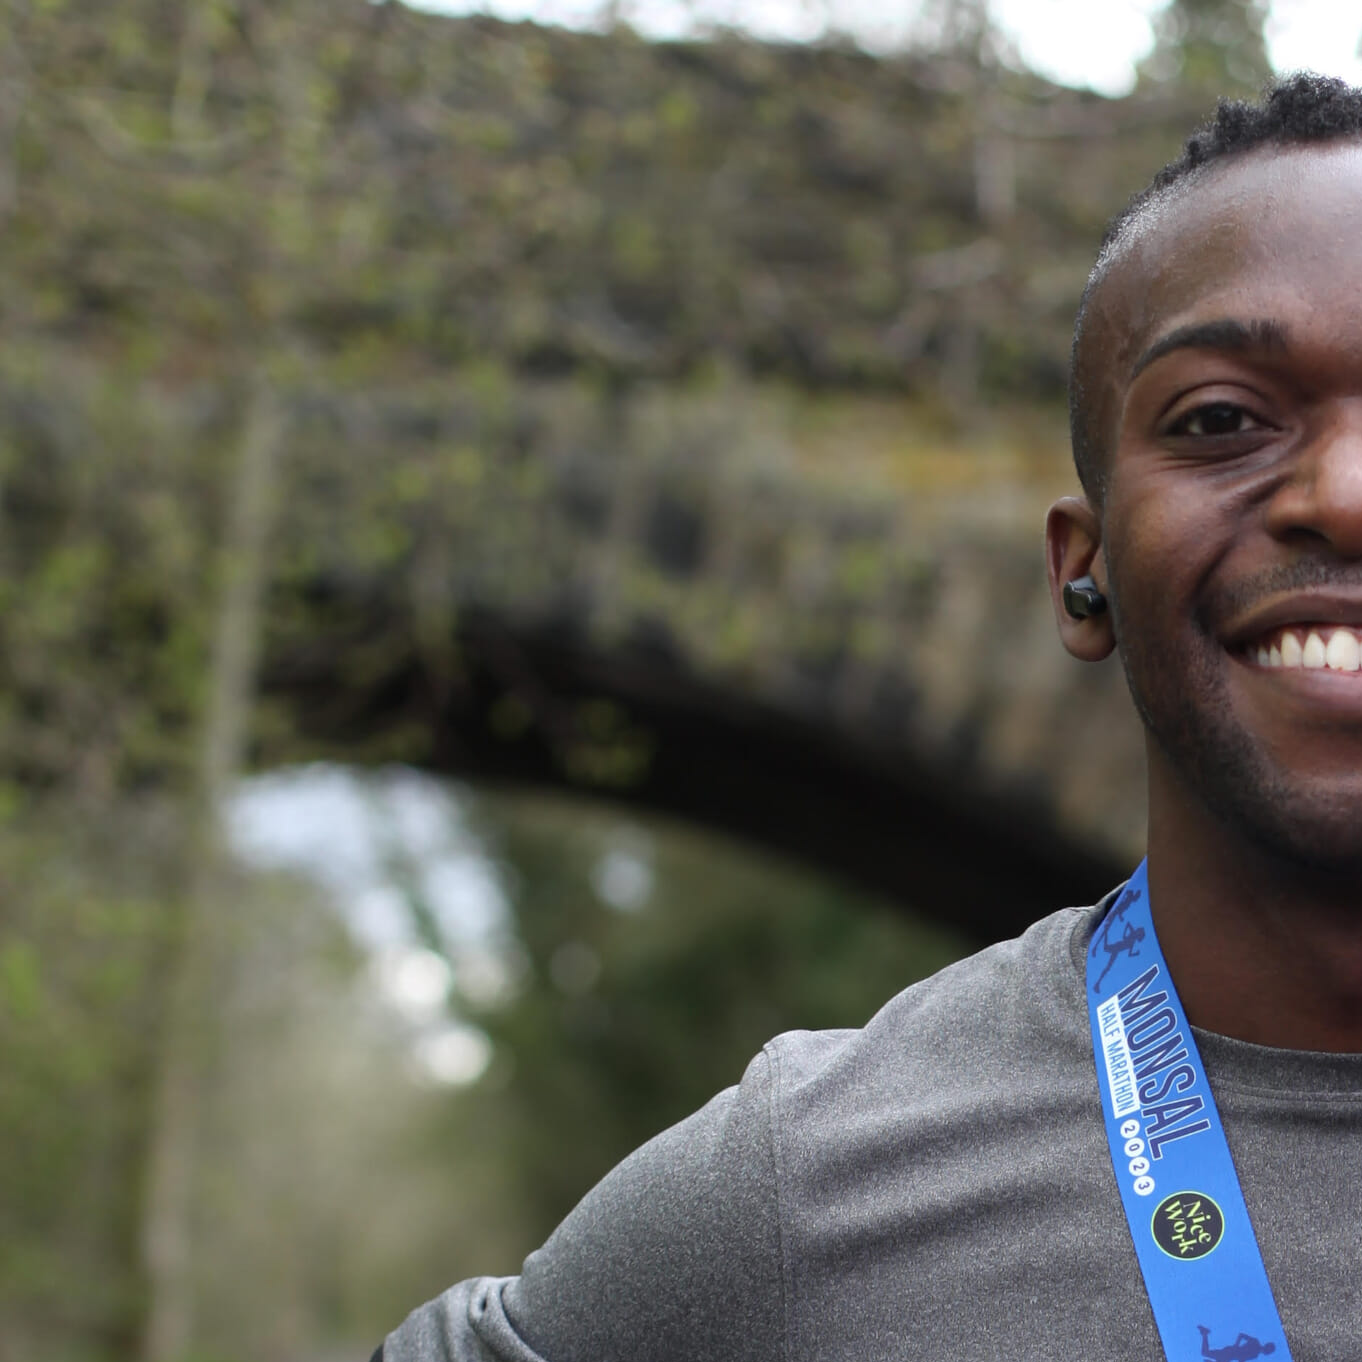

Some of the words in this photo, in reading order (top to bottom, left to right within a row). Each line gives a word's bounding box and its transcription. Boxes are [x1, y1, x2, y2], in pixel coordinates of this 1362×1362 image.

[1101, 1003, 1121, 1042] HALF
[1106, 1043, 1136, 1113] MARATHON
[1117, 963, 1211, 1161] MONSAL
[1121, 1120, 1153, 1194] 2023
[1164, 1200, 1193, 1254] Work
[1183, 1200, 1212, 1244] Nice
